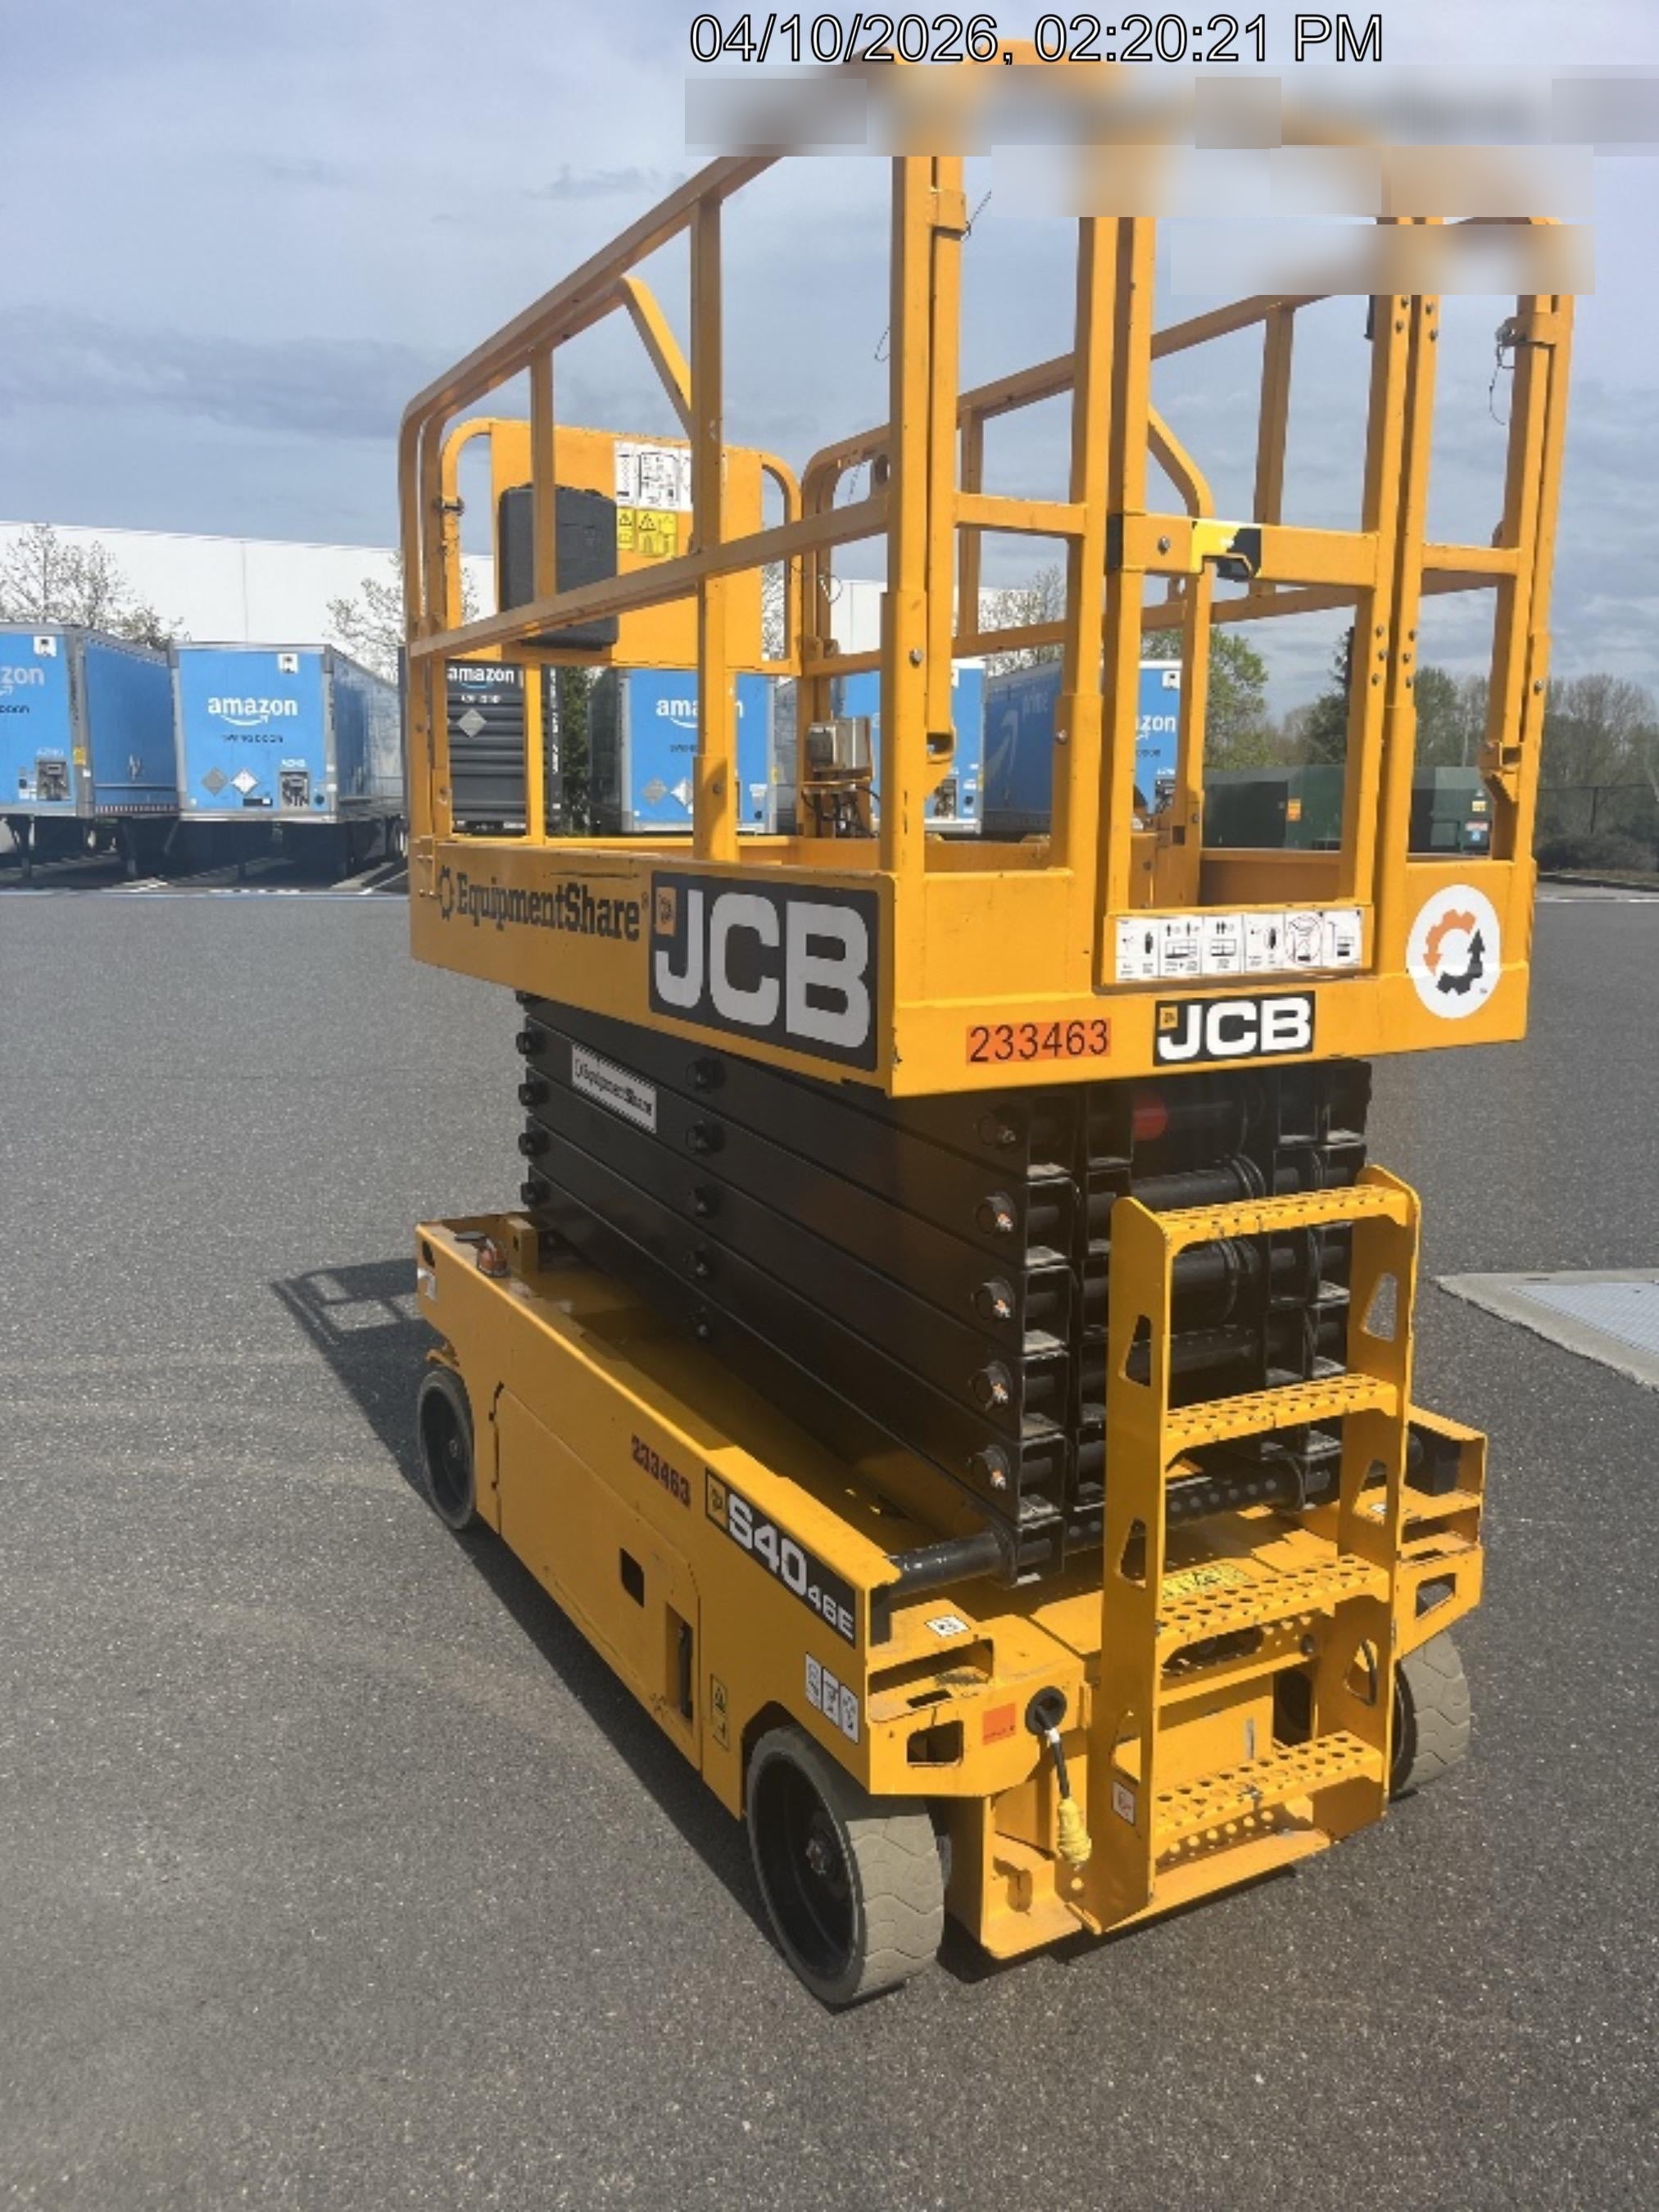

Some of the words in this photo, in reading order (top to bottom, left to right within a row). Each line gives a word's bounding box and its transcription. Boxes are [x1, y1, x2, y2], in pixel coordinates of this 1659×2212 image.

[207, 696, 299, 717] amazon
[446, 666, 514, 684] amazon
[456, 873, 641, 942] EquipmentShare
[655, 889, 871, 1049] JCB
[969, 1019, 1109, 1063] 233463
[1157, 996, 1312, 1061] JCB
[631, 1435, 691, 1509] 233463
